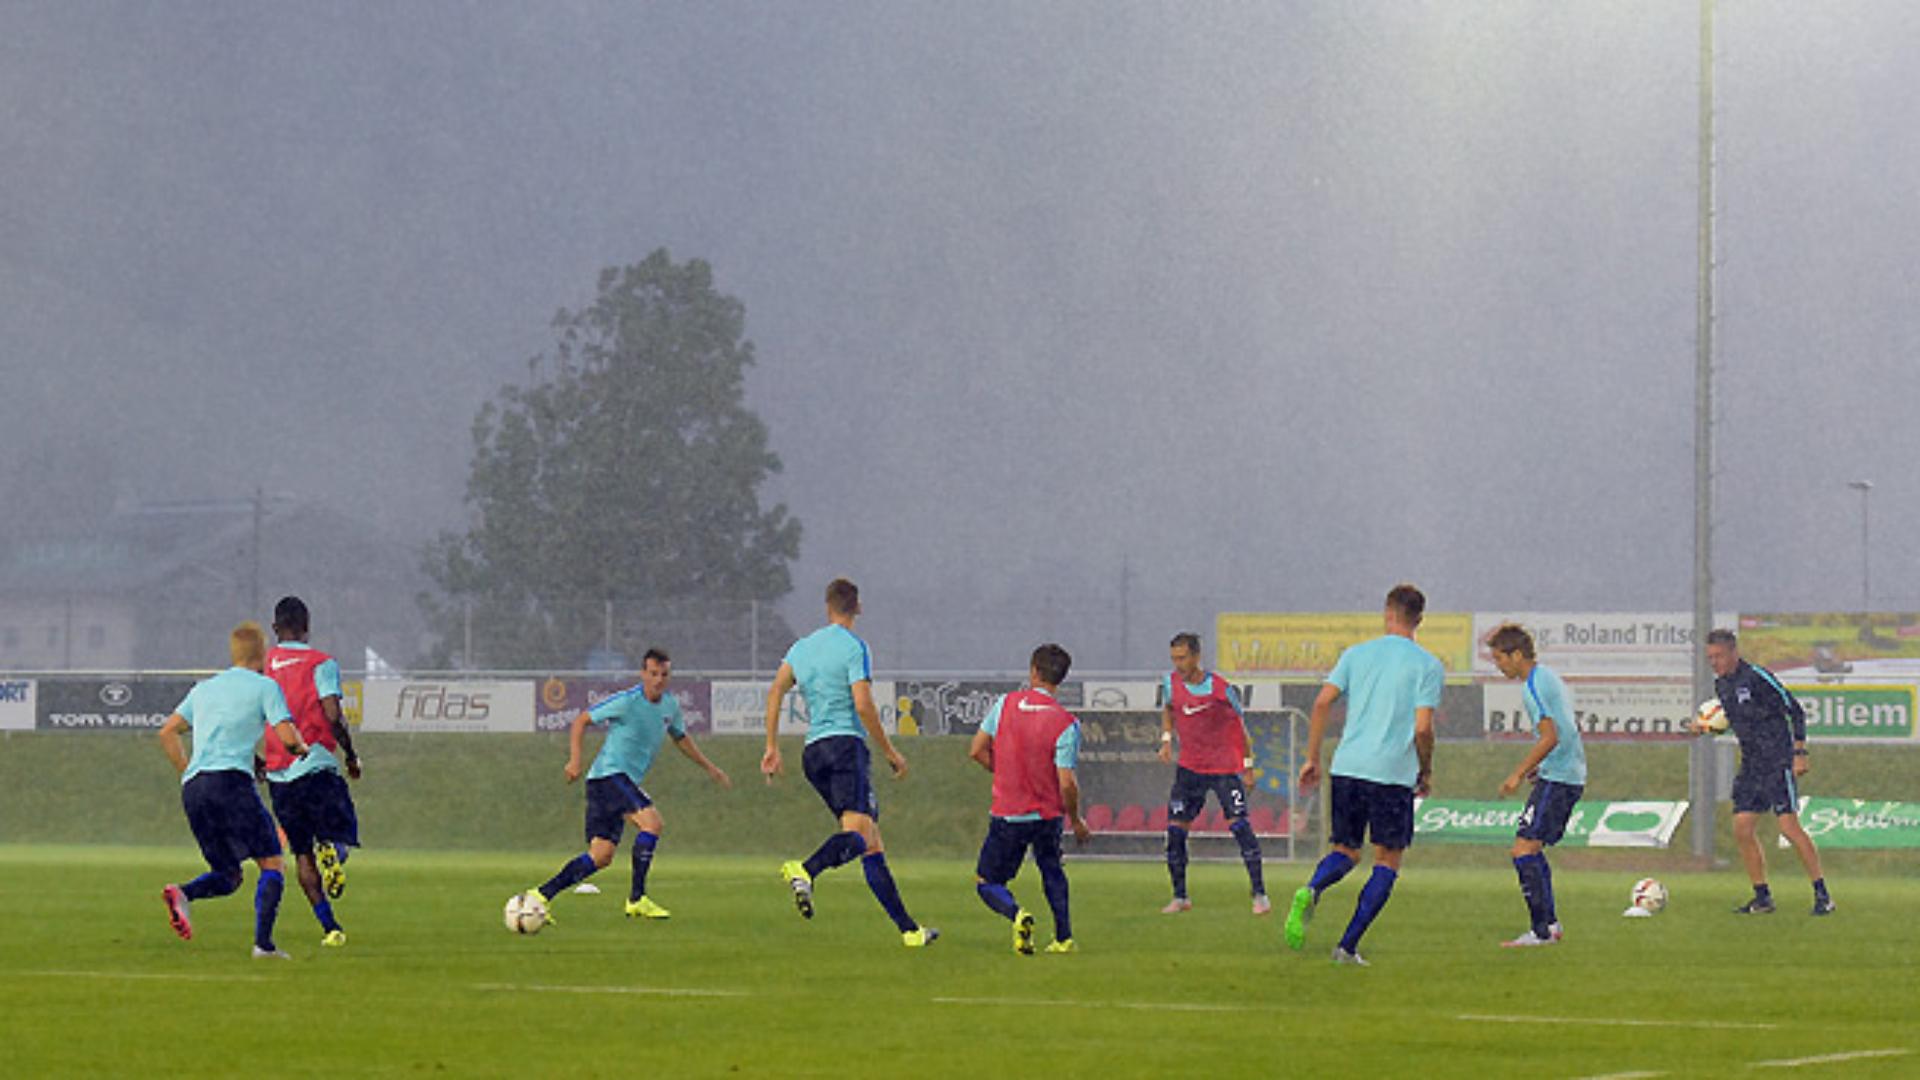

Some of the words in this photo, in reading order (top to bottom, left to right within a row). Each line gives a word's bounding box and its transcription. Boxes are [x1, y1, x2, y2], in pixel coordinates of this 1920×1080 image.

[1564, 623, 1637, 645] Roland
[1643, 623, 1697, 645] Tritsc
[395, 685, 492, 720] fidas
[1803, 697, 1907, 727] Bliem
[50, 713, 103, 727] TOM
[107, 713, 168, 727] TAILO
[1489, 710, 1696, 736] BLtrans
[1231, 789, 1243, 806] 2
